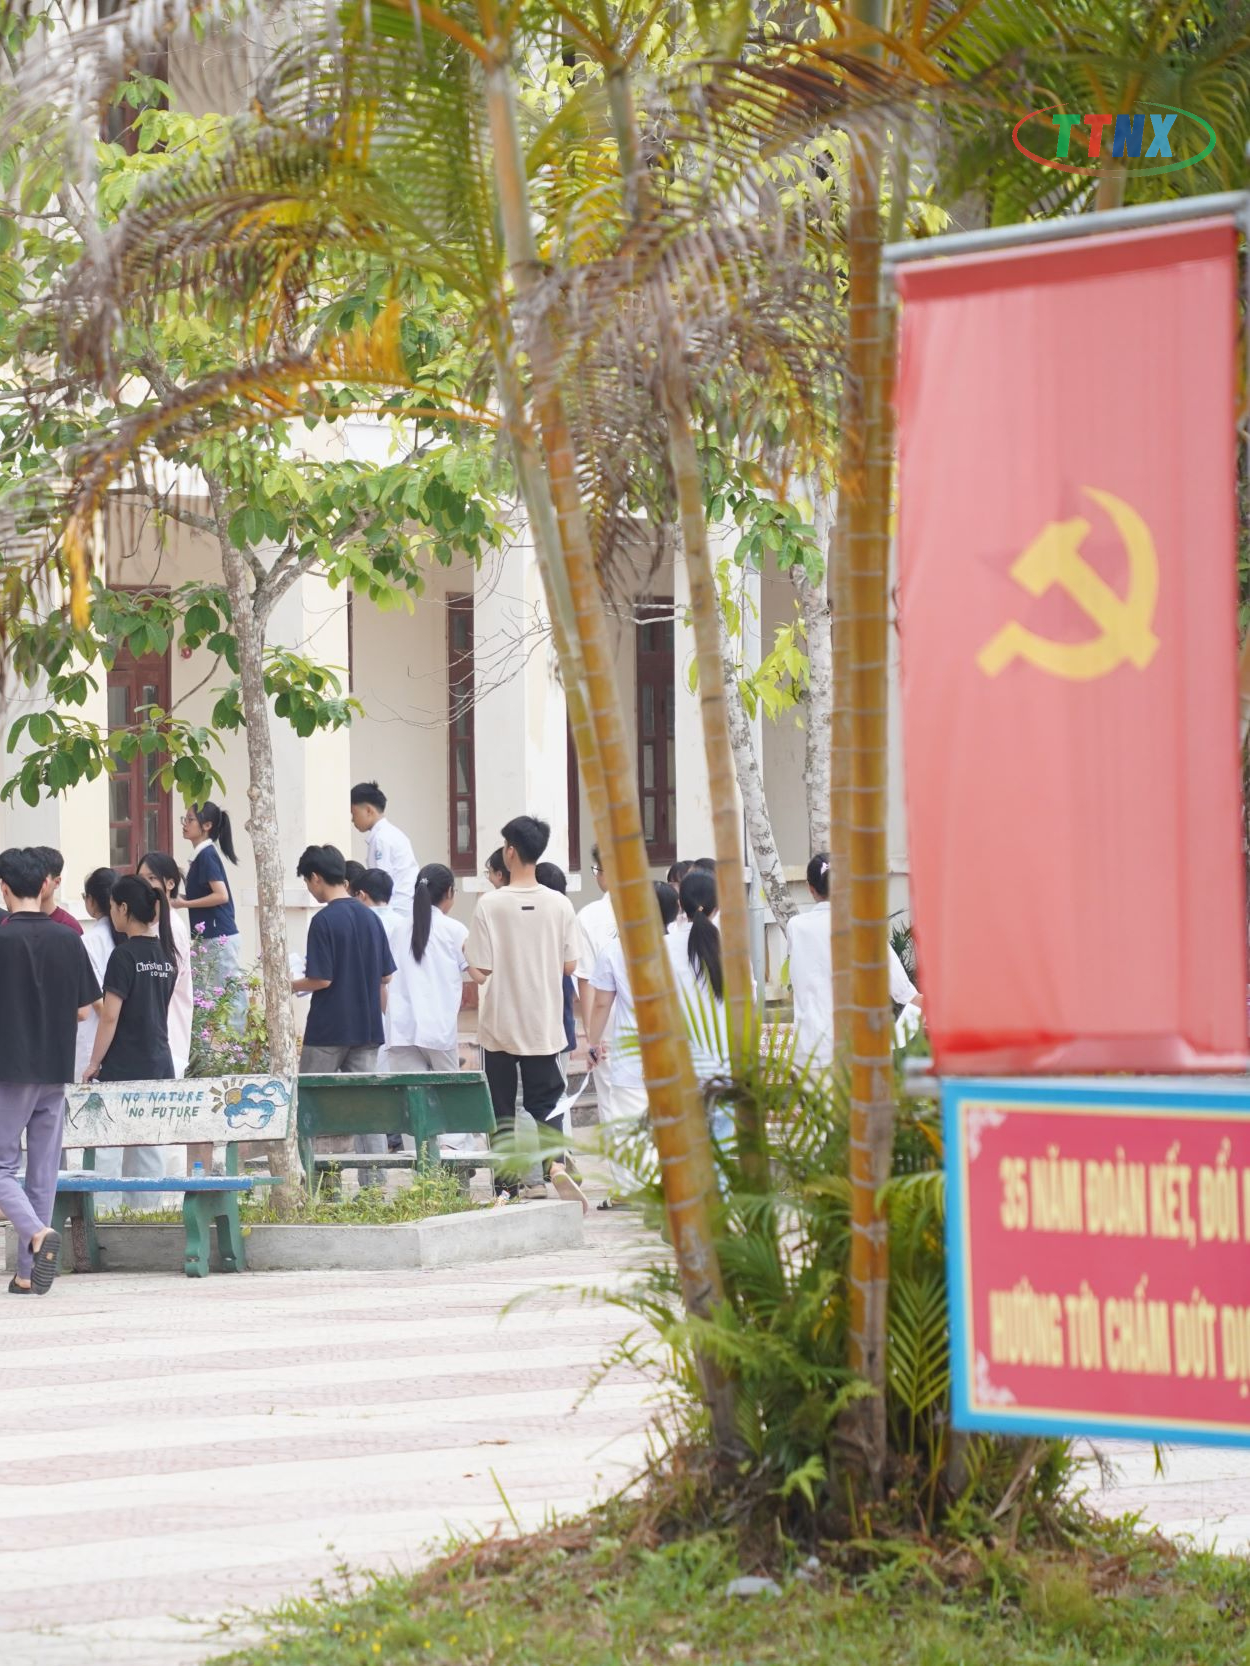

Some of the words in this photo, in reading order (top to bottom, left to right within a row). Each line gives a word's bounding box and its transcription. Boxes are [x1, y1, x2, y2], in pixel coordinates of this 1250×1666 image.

[121, 1091, 141, 1107] NO
[149, 1090, 205, 1105] NATURE
[128, 1107, 145, 1118] NO
[151, 1106, 200, 1119] FUTURE
[1000, 1157, 1029, 1231] 35
[1220, 1304, 1250, 1399] DỊ
